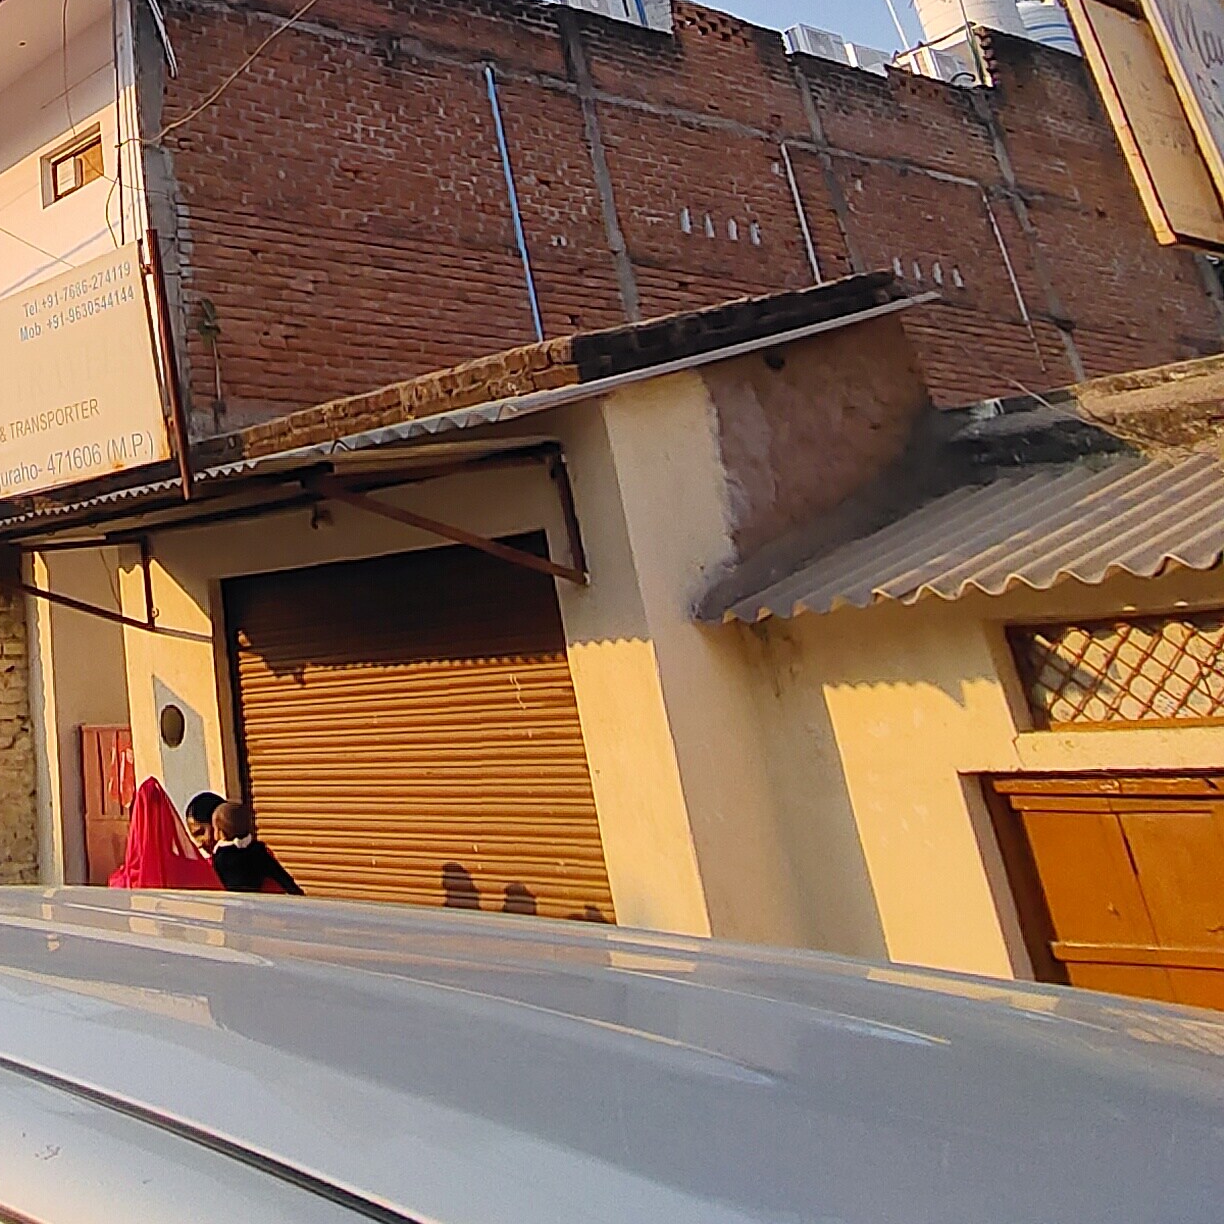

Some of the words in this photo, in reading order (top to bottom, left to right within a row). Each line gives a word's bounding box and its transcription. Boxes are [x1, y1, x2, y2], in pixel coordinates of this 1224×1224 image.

[0, 426, 8, 443] &
[9, 398, 101, 439] TRANSPORTER
[46, 442, 102, 476] 471606
[106, 430, 155, 466] (M.P.)
